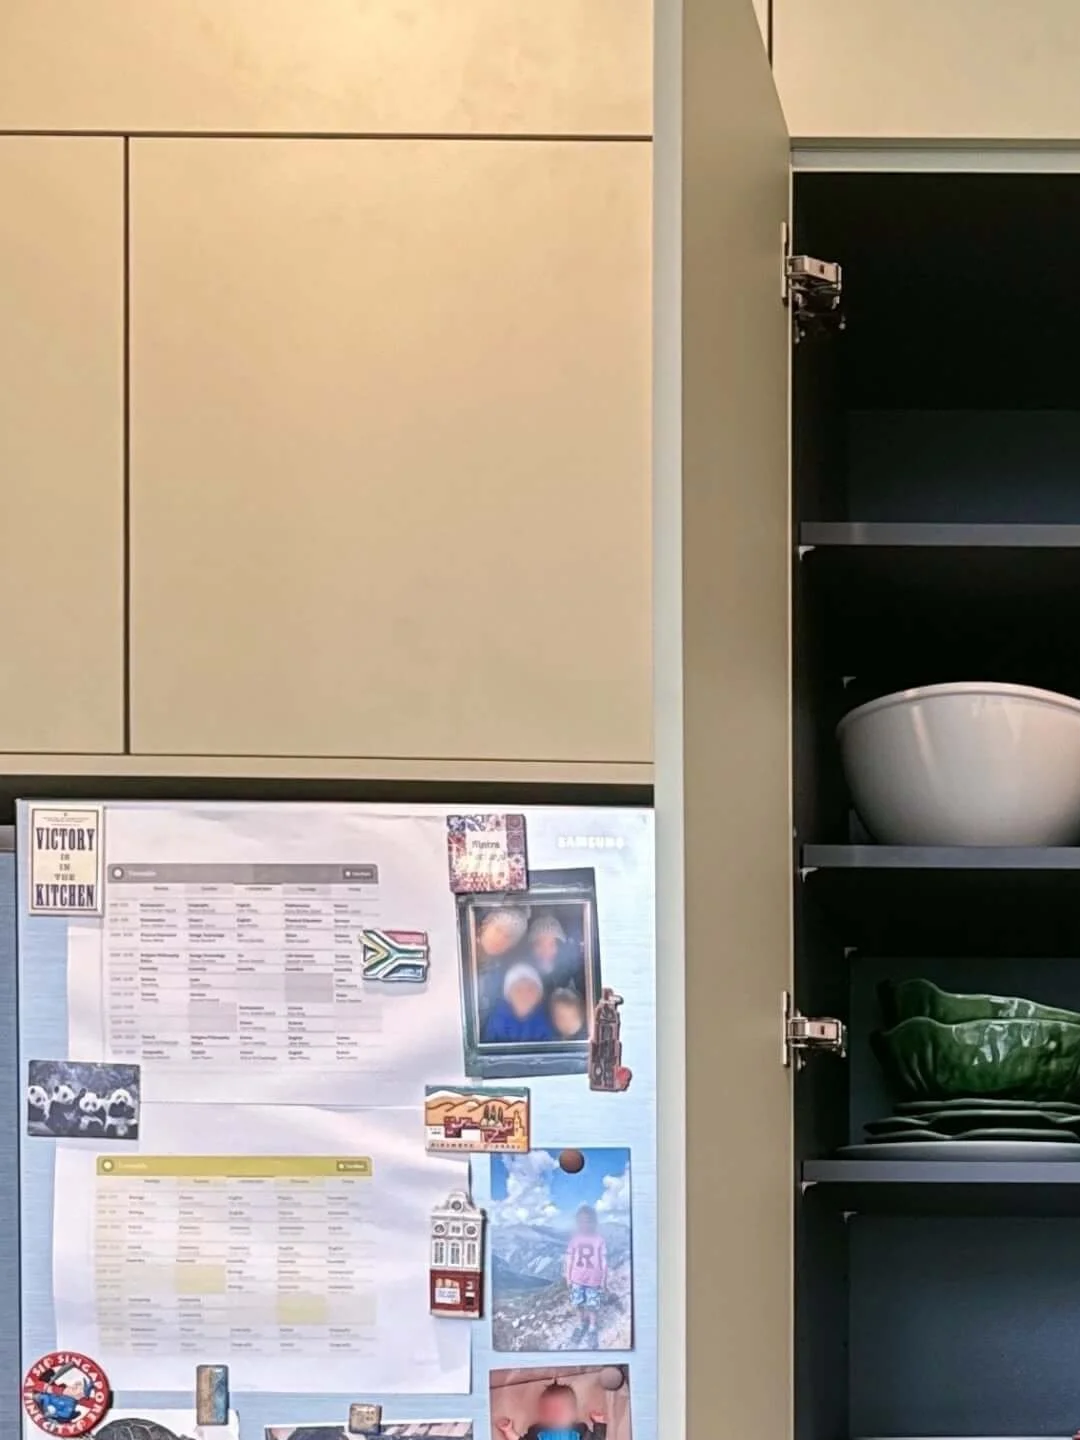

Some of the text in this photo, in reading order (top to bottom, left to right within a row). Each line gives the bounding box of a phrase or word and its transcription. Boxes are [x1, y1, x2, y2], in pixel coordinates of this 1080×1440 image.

[36, 827, 95, 851] VICTORY
[60, 853, 70, 861] IS
[59, 863, 71, 872] IN
[54, 873, 75, 881] THE
[35, 883, 94, 907] KITCHEN
[576, 1243, 594, 1268] R
